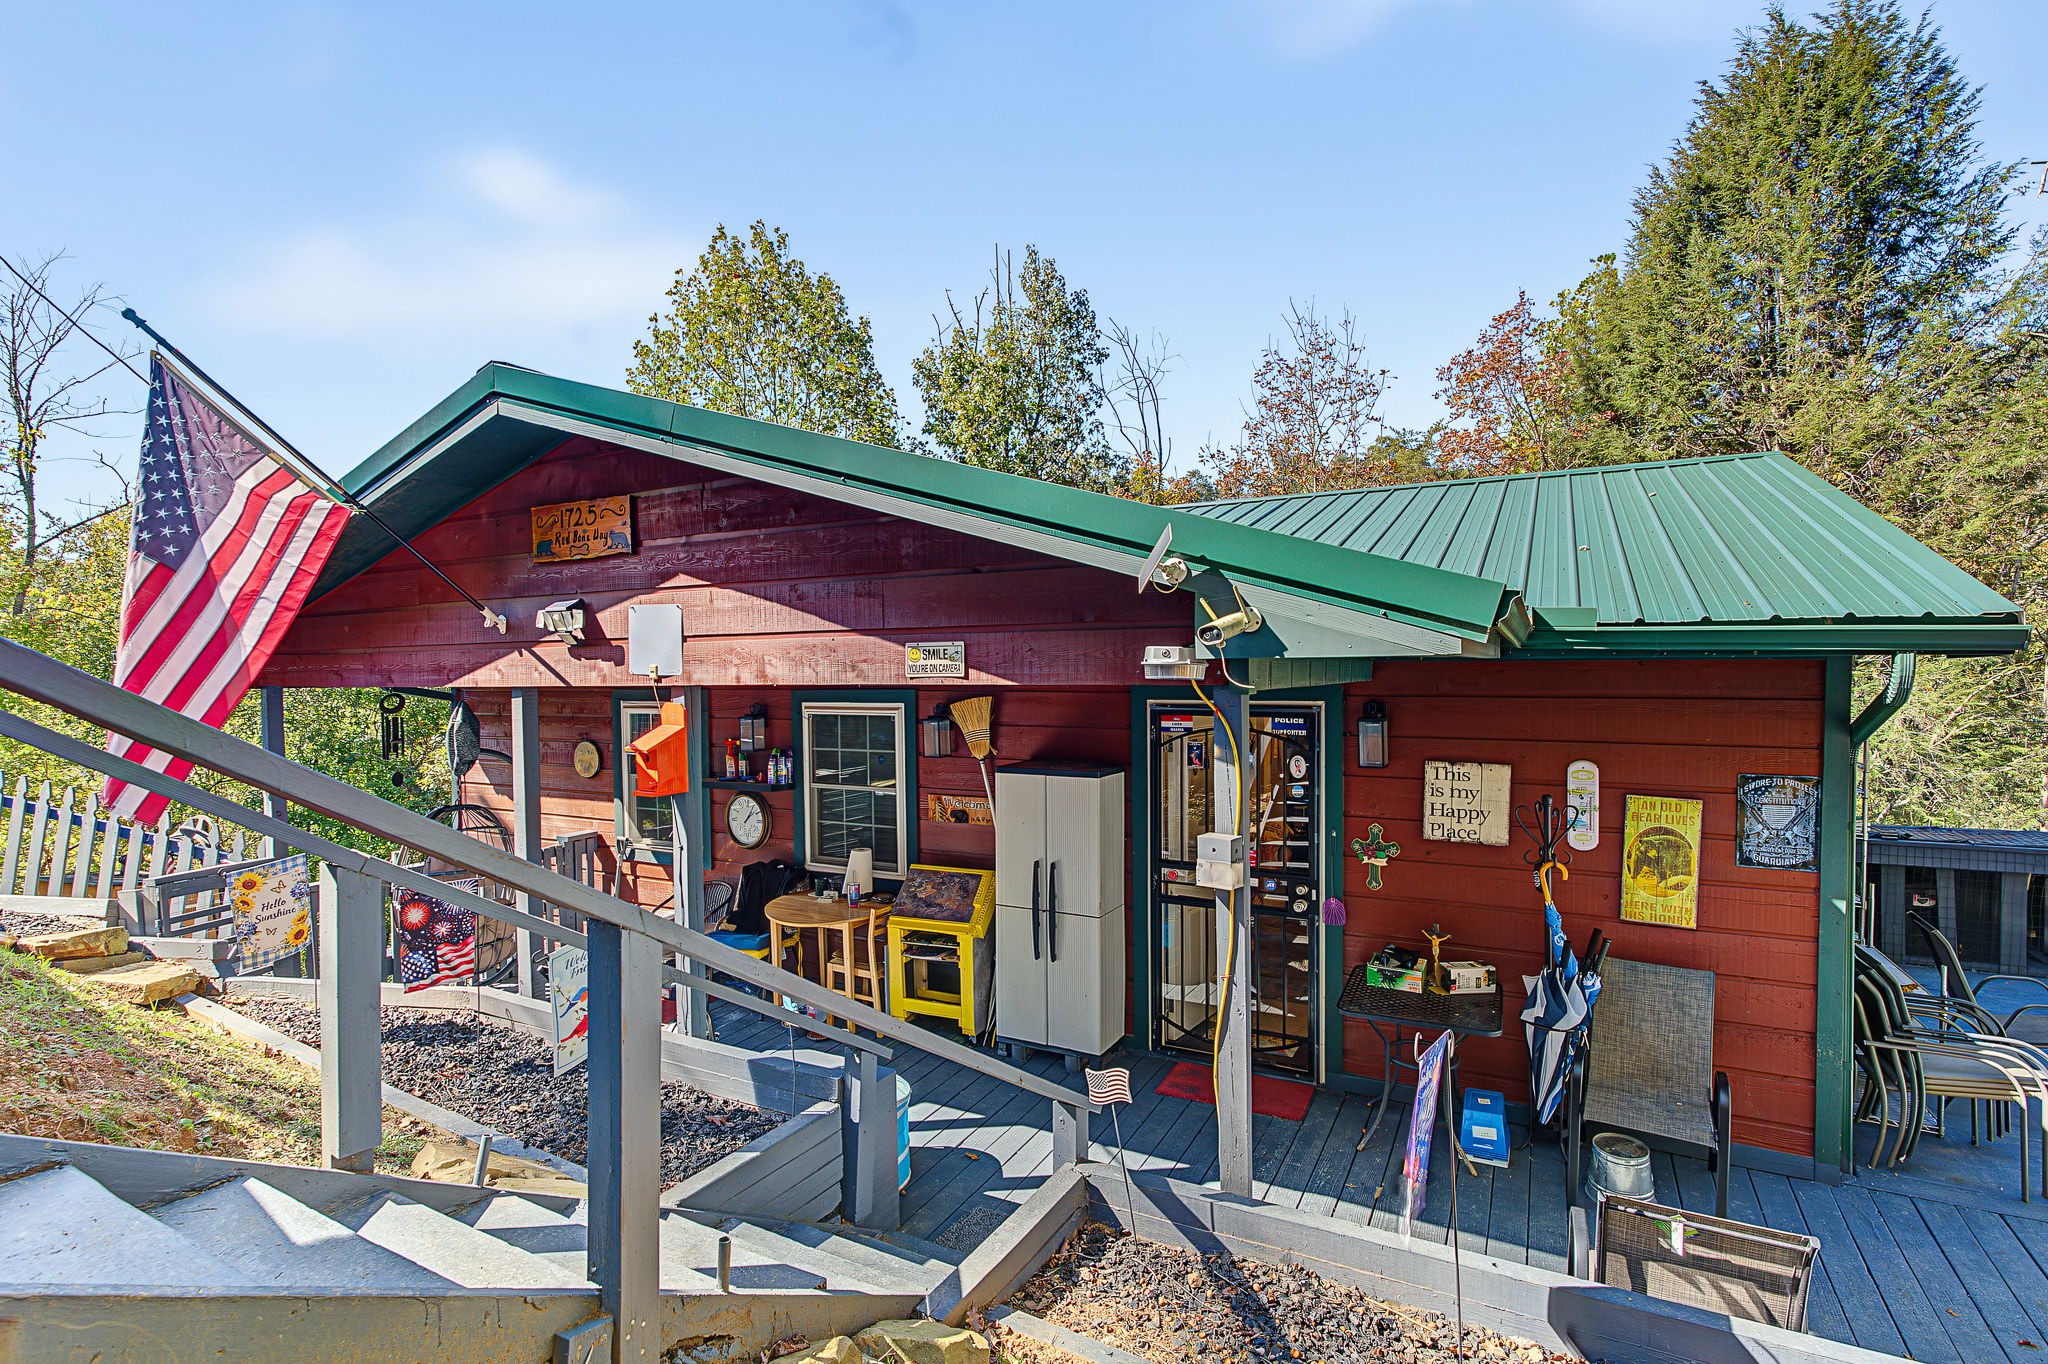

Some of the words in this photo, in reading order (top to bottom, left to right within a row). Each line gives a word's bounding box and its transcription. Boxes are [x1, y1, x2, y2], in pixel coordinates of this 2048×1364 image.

[560, 504, 597, 528] 1725
[555, 530, 571, 548] Red
[922, 648, 949, 661] SMILE
[929, 663, 938, 673] ON
[938, 663, 961, 673] CAMERA
[1430, 765, 1471, 782] This
[1429, 782, 1445, 797] is
[1450, 787, 1480, 805] my
[943, 797, 991, 809] Welcome
[1641, 800, 1657, 811] AN
[1660, 802, 1683, 814] OLD
[1429, 802, 1492, 826] Happy
[1631, 811, 1661, 824] BEAR
[1665, 814, 1696, 827] LIVES
[261, 897, 287, 913] Hello
[1624, 899, 1658, 912] HERE
[1660, 902, 1693, 916] WITH
[254, 907, 297, 925] Sunshine
[1623, 908, 1645, 921] HIS
[1649, 912, 1693, 926] HONEY
